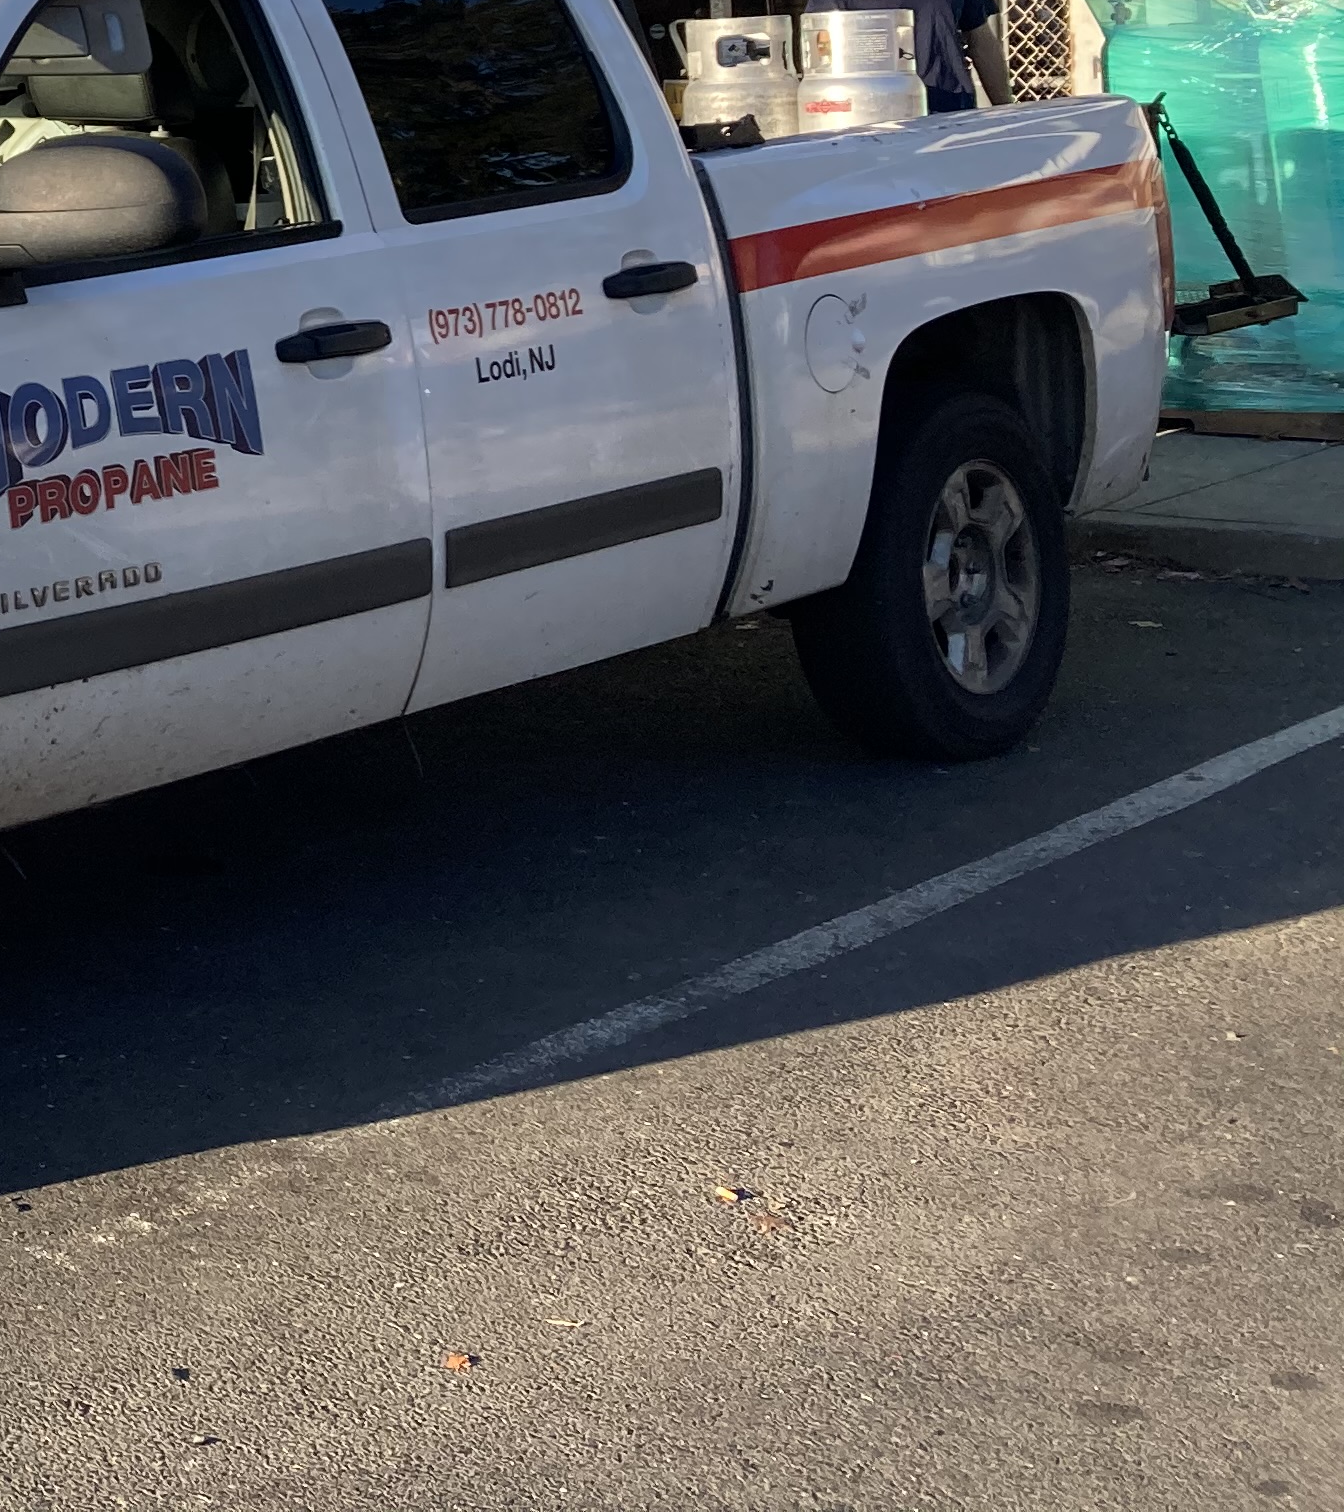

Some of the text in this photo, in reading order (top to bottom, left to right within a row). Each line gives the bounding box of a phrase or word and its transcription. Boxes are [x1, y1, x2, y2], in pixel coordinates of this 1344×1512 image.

[428, 288, 583, 345] (973) 778-0812
[475, 344, 556, 384] Lodi, NJ
[8, 448, 219, 530] PROPANE
